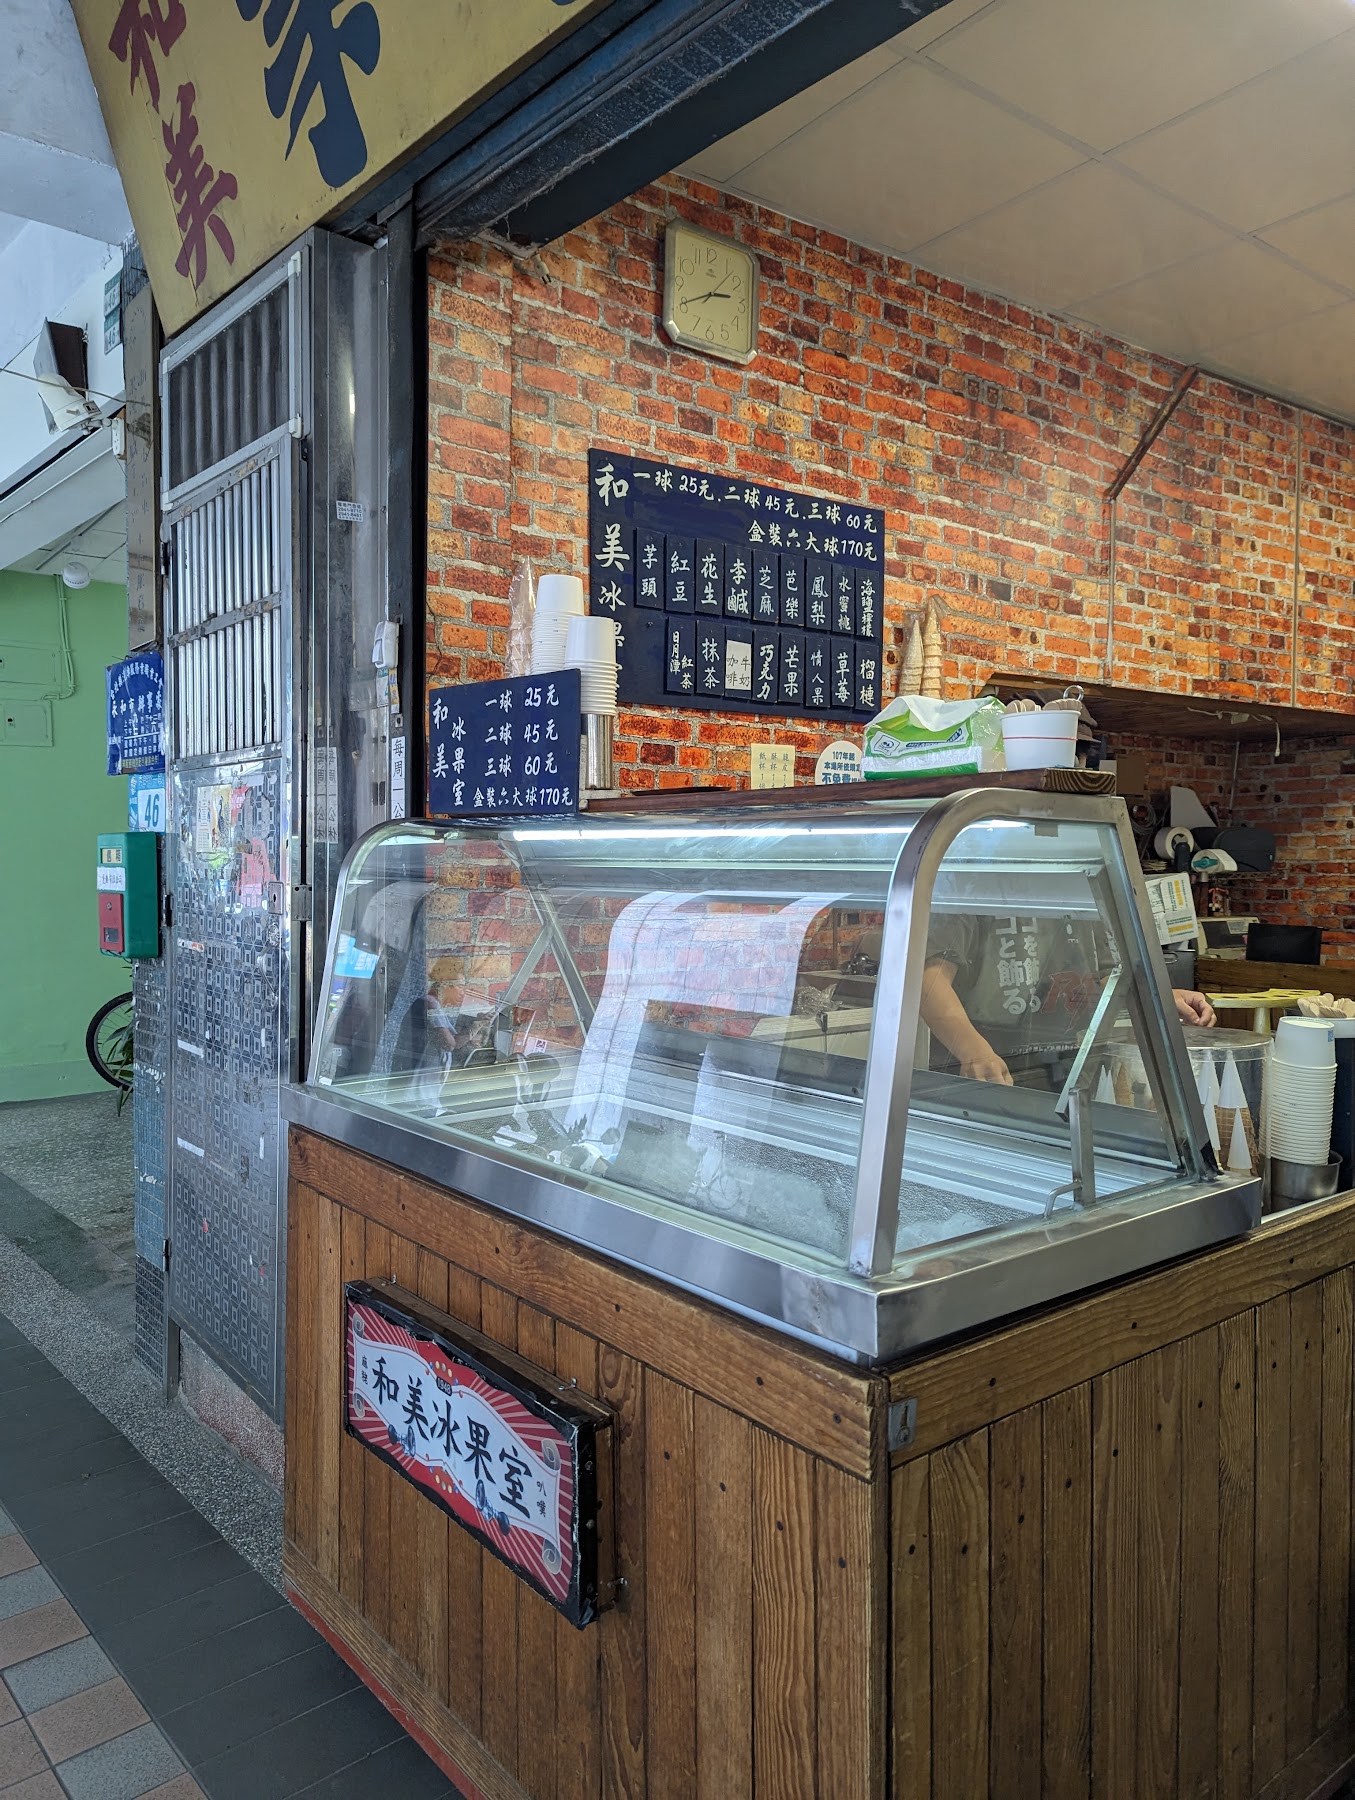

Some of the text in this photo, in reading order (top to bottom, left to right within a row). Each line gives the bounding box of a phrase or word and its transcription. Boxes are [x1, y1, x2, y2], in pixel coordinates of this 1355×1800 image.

[678, 256, 695, 276] 10
[707, 248, 718, 264] 12
[675, 275, 685, 292] 9
[679, 296, 689, 314] 8
[733, 275, 742, 291] 2
[737, 299, 746, 314] 3
[692, 315, 701, 331] 7
[705, 325, 715, 341] 6
[721, 323, 730, 341] 5
[731, 315, 739, 331] 4
[594, 462, 631, 689] 和美冰
[640, 544, 658, 598] 芋頭
[670, 551, 691, 602] 紅豆
[700, 553, 719, 605] 花生
[727, 558, 750, 615] 李鹹
[759, 565, 775, 616] 芝麻
[785, 570, 799, 619] 芭樂
[810, 575, 829, 626] 鳳梨
[838, 576, 852, 631] 水蜜桃
[669, 630, 694, 690] 日月潭 紅茶
[701, 638, 720, 689] 抹茶
[726, 654, 751, 687] 牛奶 咖啡
[757, 644, 775, 700] 巧克力
[783, 645, 800, 698] 芒果
[810, 649, 825, 706] 情人果
[834, 652, 851, 703] 草莓
[485, 683, 559, 713] 一球 25元
[432, 697, 449, 779] 和美
[485, 718, 559, 746] 二球 45元
[451, 716, 467, 807] 冰果室
[484, 751, 558, 778] 三球 60元
[144, 793, 160, 828] 46
[372, 1355, 532, 1520] 和美冰果室
